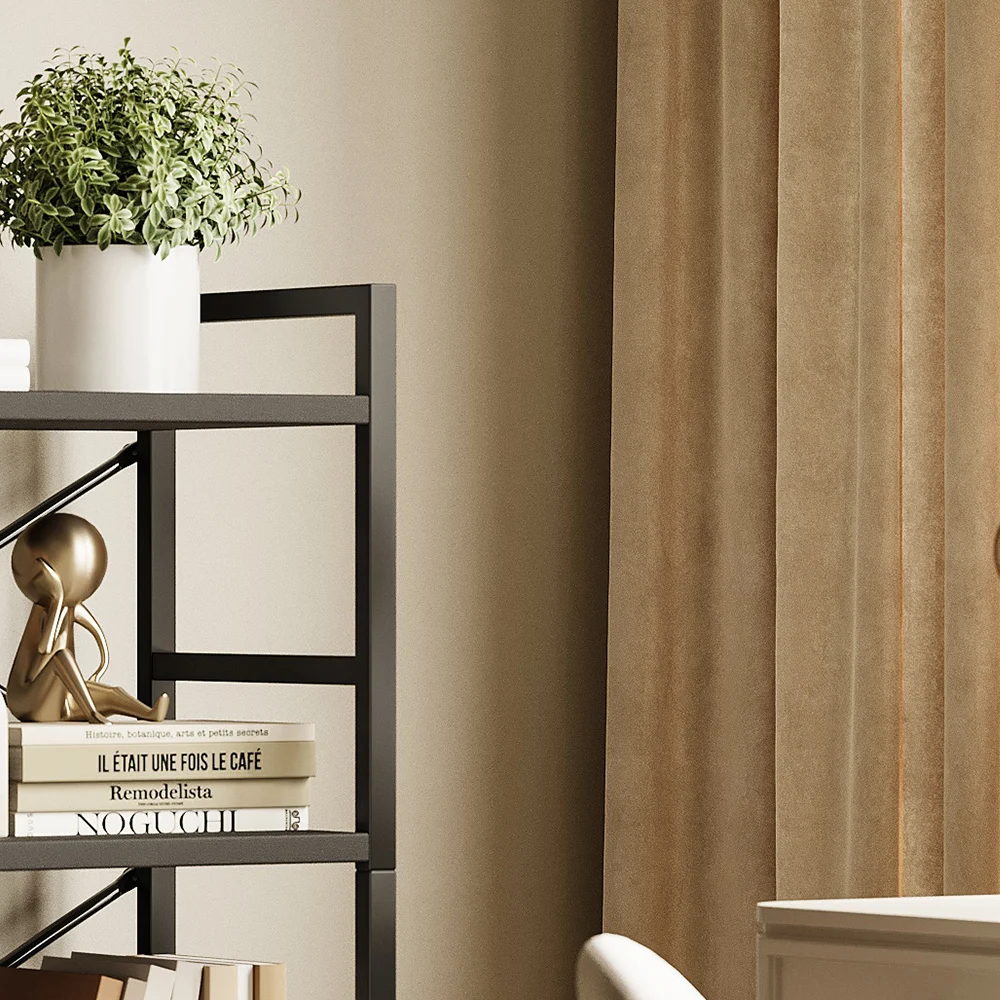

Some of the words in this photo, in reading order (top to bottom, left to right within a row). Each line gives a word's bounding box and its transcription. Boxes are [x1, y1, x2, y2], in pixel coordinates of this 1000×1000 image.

[85, 730, 124, 740] Histoire,
[127, 729, 174, 740] botanique,
[176, 730, 194, 738] arts
[197, 730, 206, 738] et
[208, 728, 234, 738] petits
[236, 728, 270, 737] secrets
[98, 754, 110, 773] IL
[113, 750, 148, 772] ÉTAIT
[152, 753, 178, 772] UNE
[181, 752, 209, 772] FOIS
[212, 752, 226, 770] LE
[230, 748, 262, 770] CAFÉ
[110, 783, 213, 802] Remodelista
[75, 810, 238, 836] NOGUCHI
